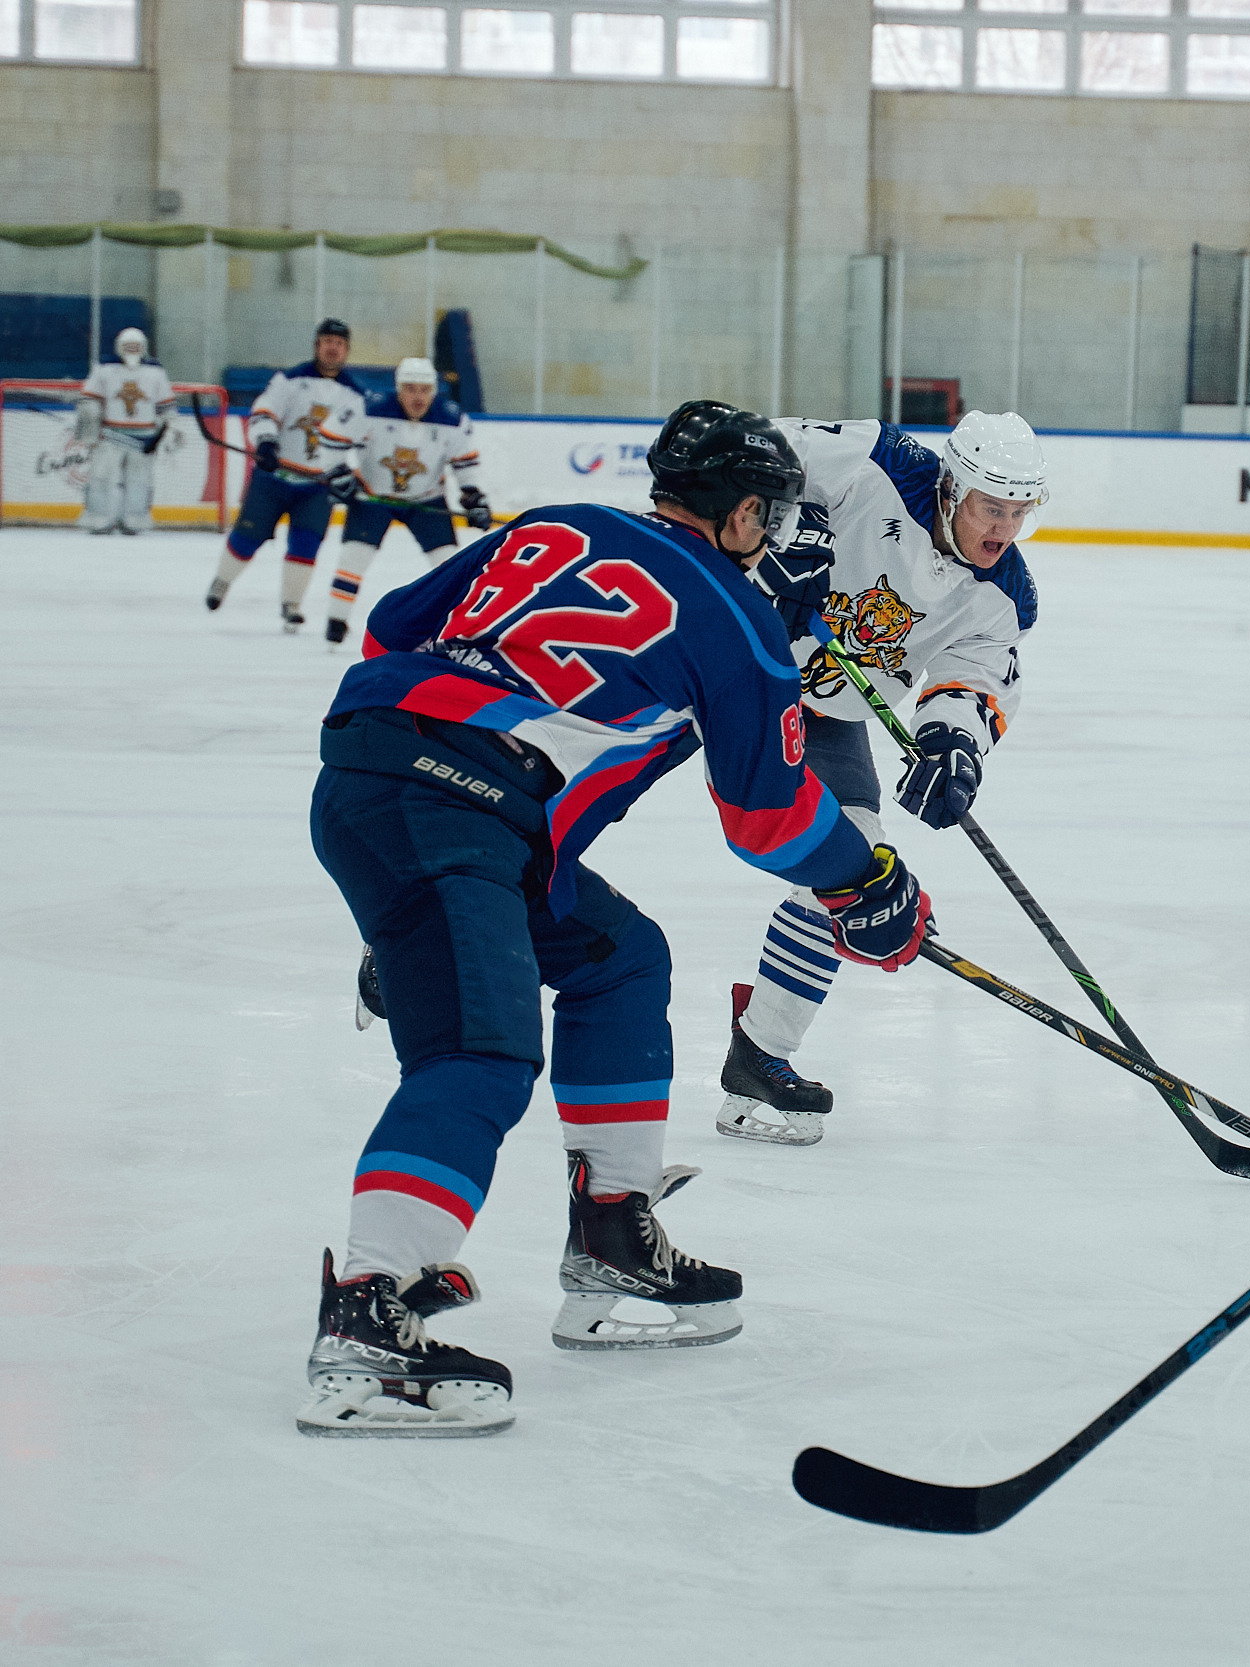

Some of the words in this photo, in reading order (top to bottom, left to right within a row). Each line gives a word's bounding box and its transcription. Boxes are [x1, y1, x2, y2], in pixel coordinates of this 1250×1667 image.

[439, 521, 678, 710] 82
[413, 756, 505, 803] BAUER
[998, 990, 1054, 1023] BAUER
[317, 1334, 424, 1374] APOR
